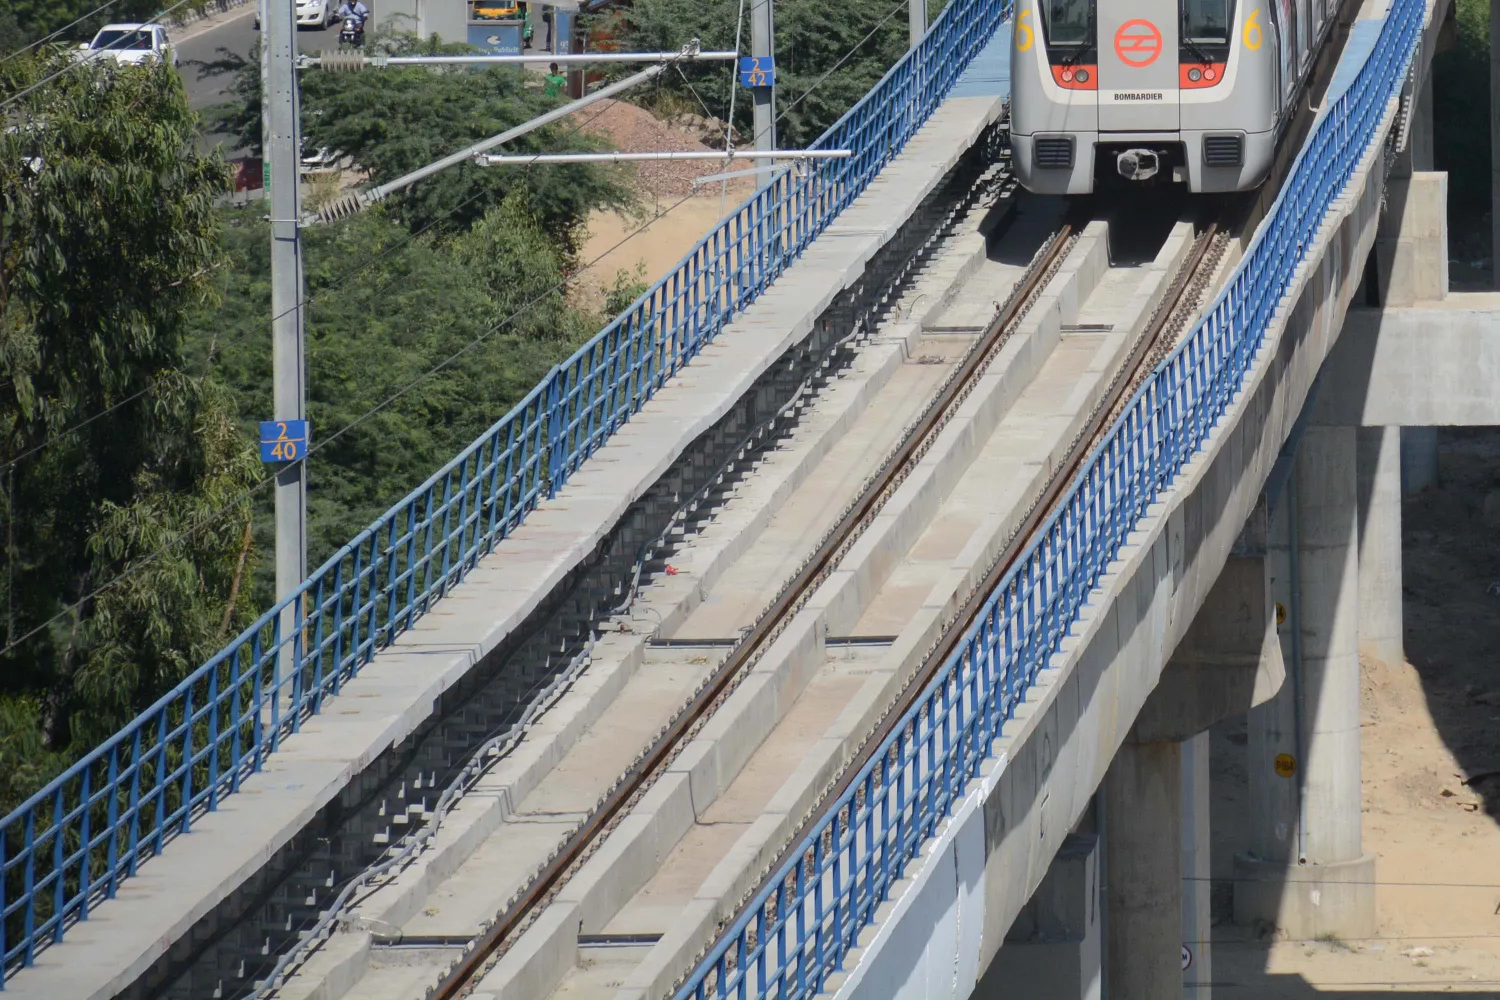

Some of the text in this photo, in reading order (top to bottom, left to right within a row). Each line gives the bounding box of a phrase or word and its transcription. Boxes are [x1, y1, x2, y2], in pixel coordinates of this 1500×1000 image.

[1016, 8, 1034, 52] 6
[1242, 7, 1263, 51] 6
[751, 57, 761, 71] 2
[747, 72, 767, 86] 42
[1113, 92, 1163, 101] BOMBARDIER
[276, 421, 288, 440] 2
[270, 441, 297, 460] 40
